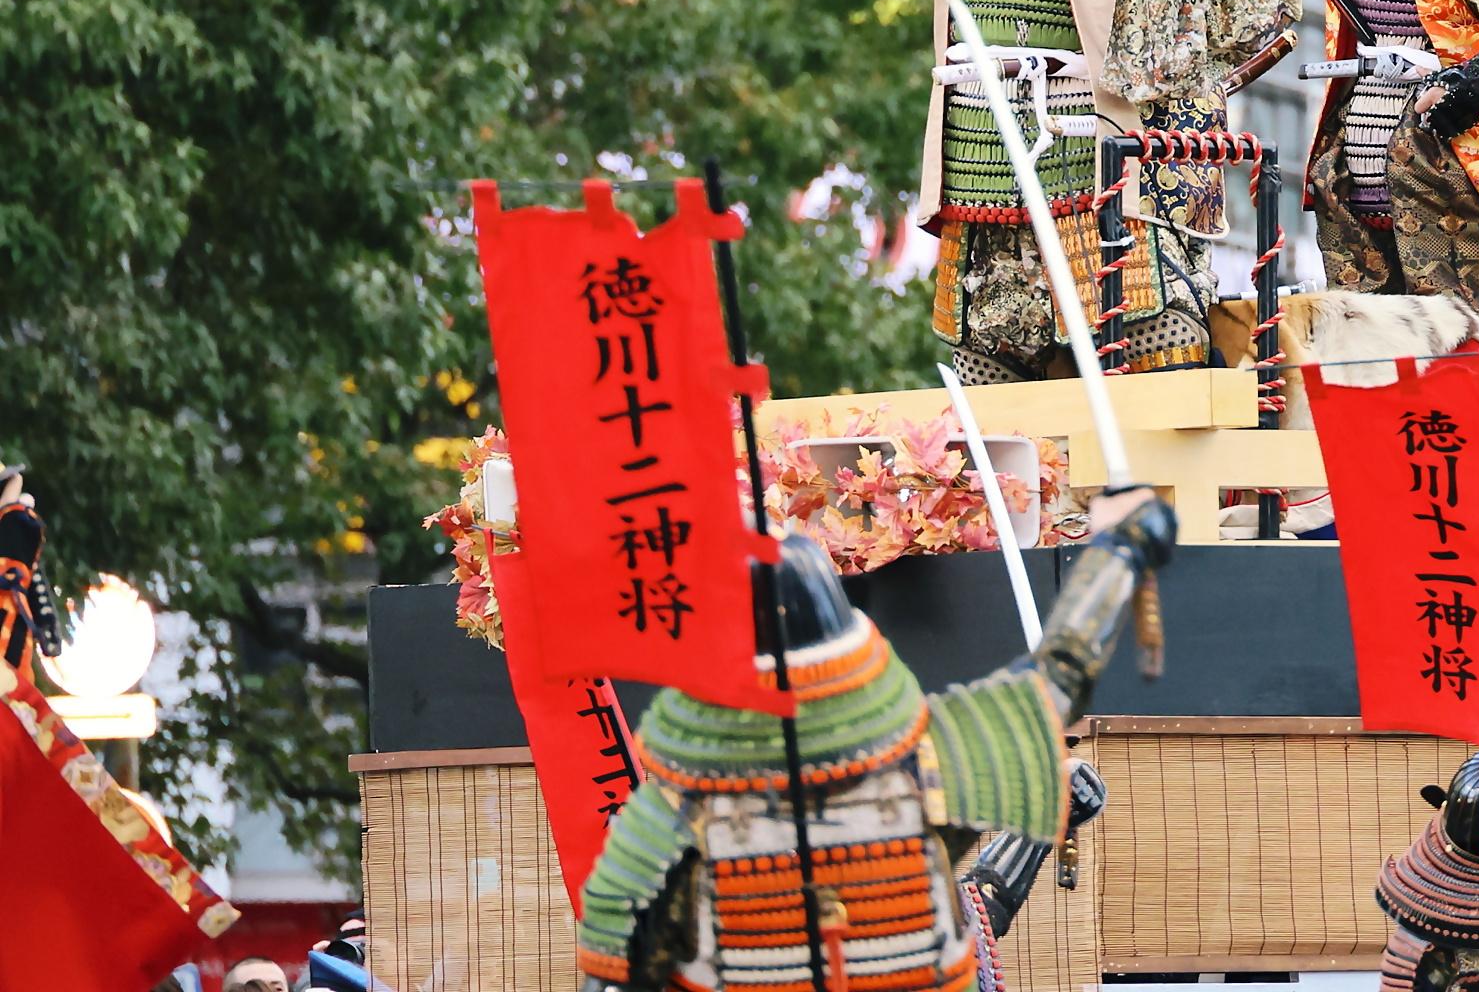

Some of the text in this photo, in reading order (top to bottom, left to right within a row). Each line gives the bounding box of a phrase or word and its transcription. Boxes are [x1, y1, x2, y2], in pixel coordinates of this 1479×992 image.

[579, 257, 695, 640] 徳川十二神将
[1396, 409, 1479, 701] 徳川十二神将
